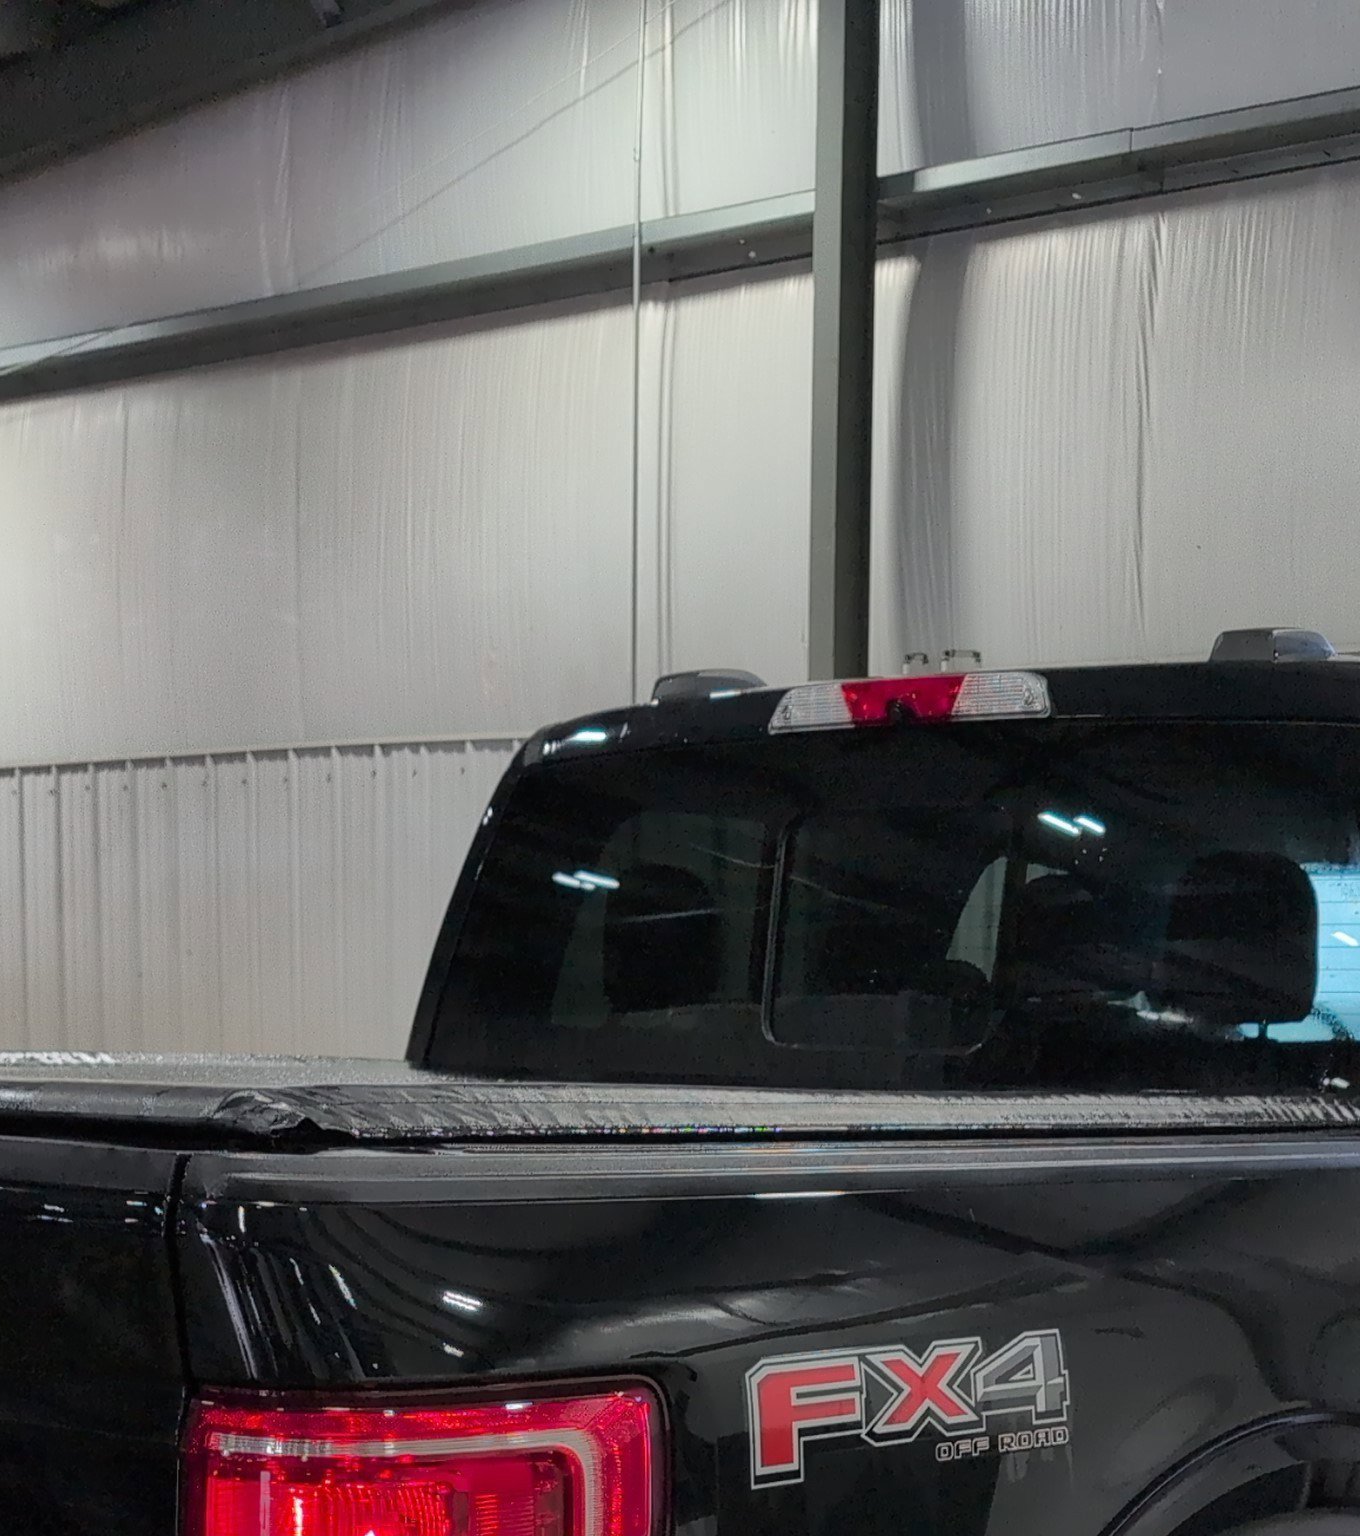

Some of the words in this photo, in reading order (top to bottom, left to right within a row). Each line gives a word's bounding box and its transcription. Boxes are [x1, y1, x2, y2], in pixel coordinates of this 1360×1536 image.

[745, 1329, 1070, 1490] FX4
[935, 1437, 989, 1462] OFF
[998, 1427, 1070, 1453] ROAD
